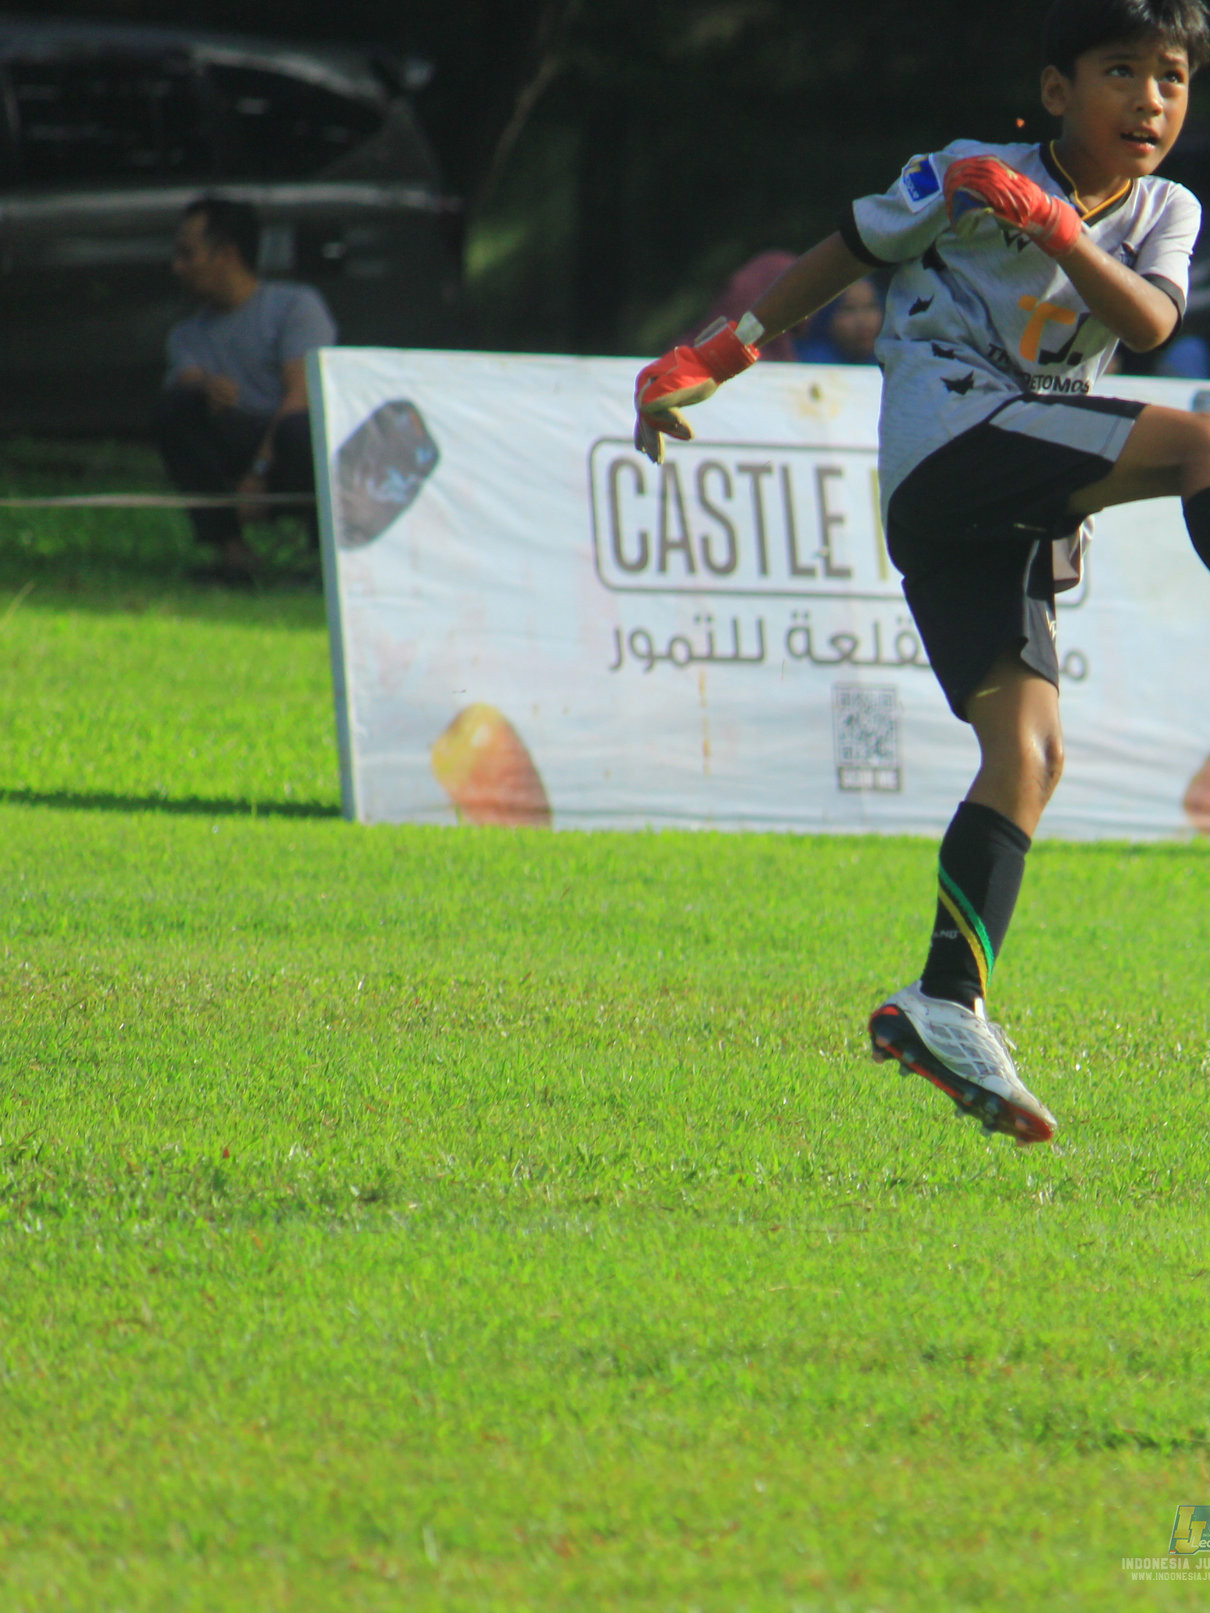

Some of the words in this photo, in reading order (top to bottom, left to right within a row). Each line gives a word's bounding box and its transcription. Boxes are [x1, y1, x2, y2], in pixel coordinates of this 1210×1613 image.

[608, 457, 853, 582] CASTLE
[608, 612, 766, 674] للتمور
[785, 609, 934, 671] قلعة
